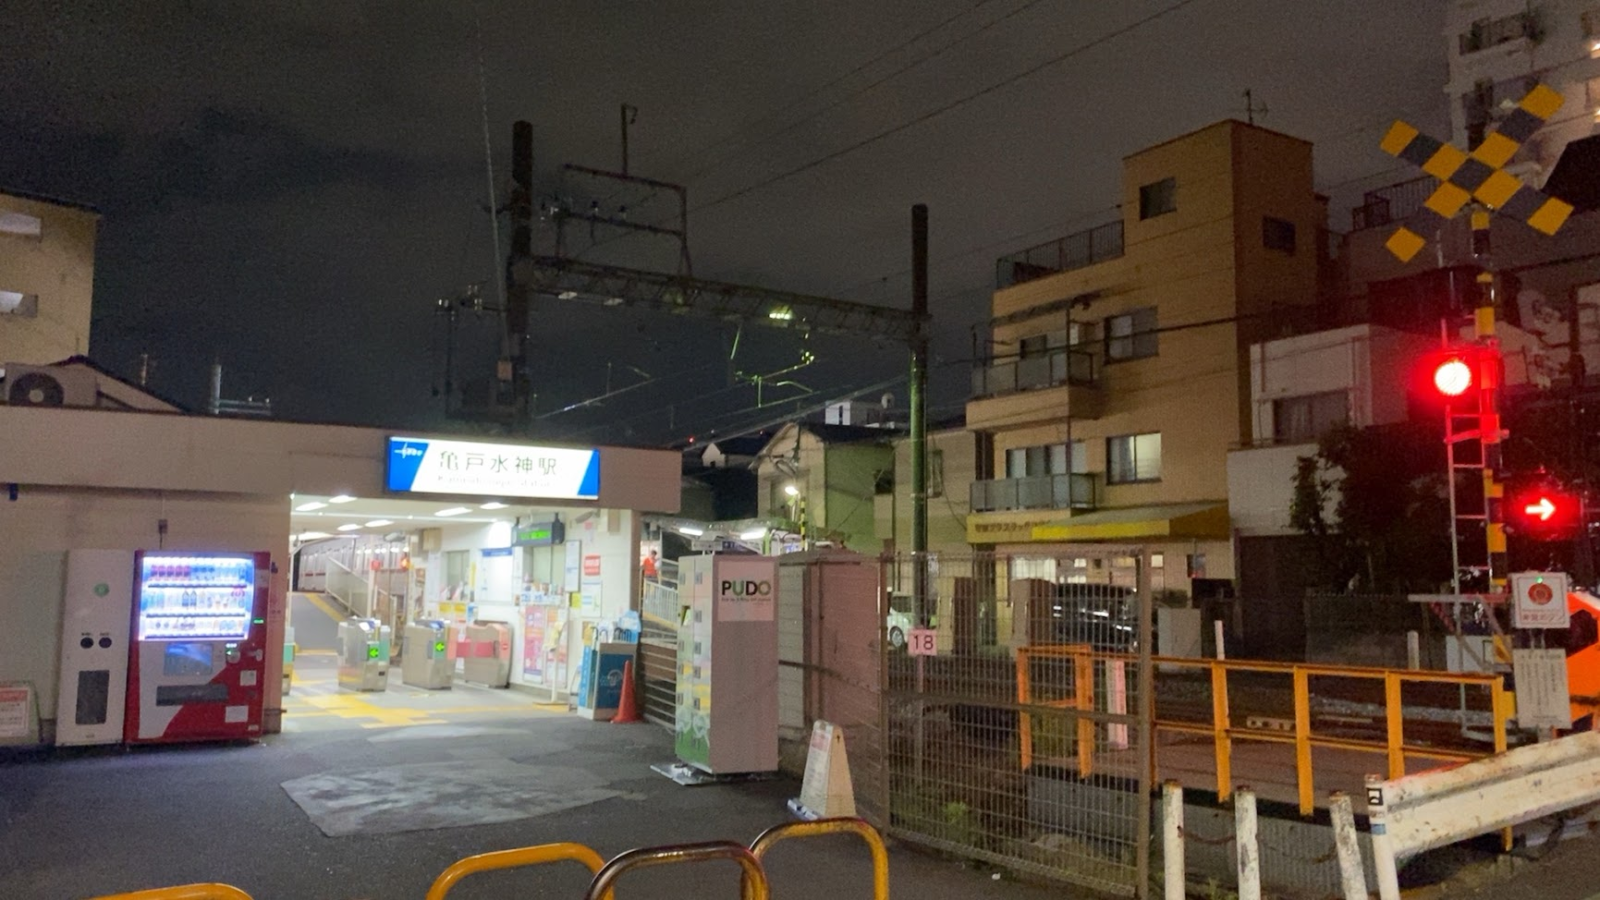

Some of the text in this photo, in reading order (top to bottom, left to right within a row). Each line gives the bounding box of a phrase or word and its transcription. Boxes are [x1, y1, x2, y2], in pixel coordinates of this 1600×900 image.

[439, 450, 558, 476] 亀戸水神駅
[721, 580, 772, 596] PUDO
[913, 634, 934, 651] 18
